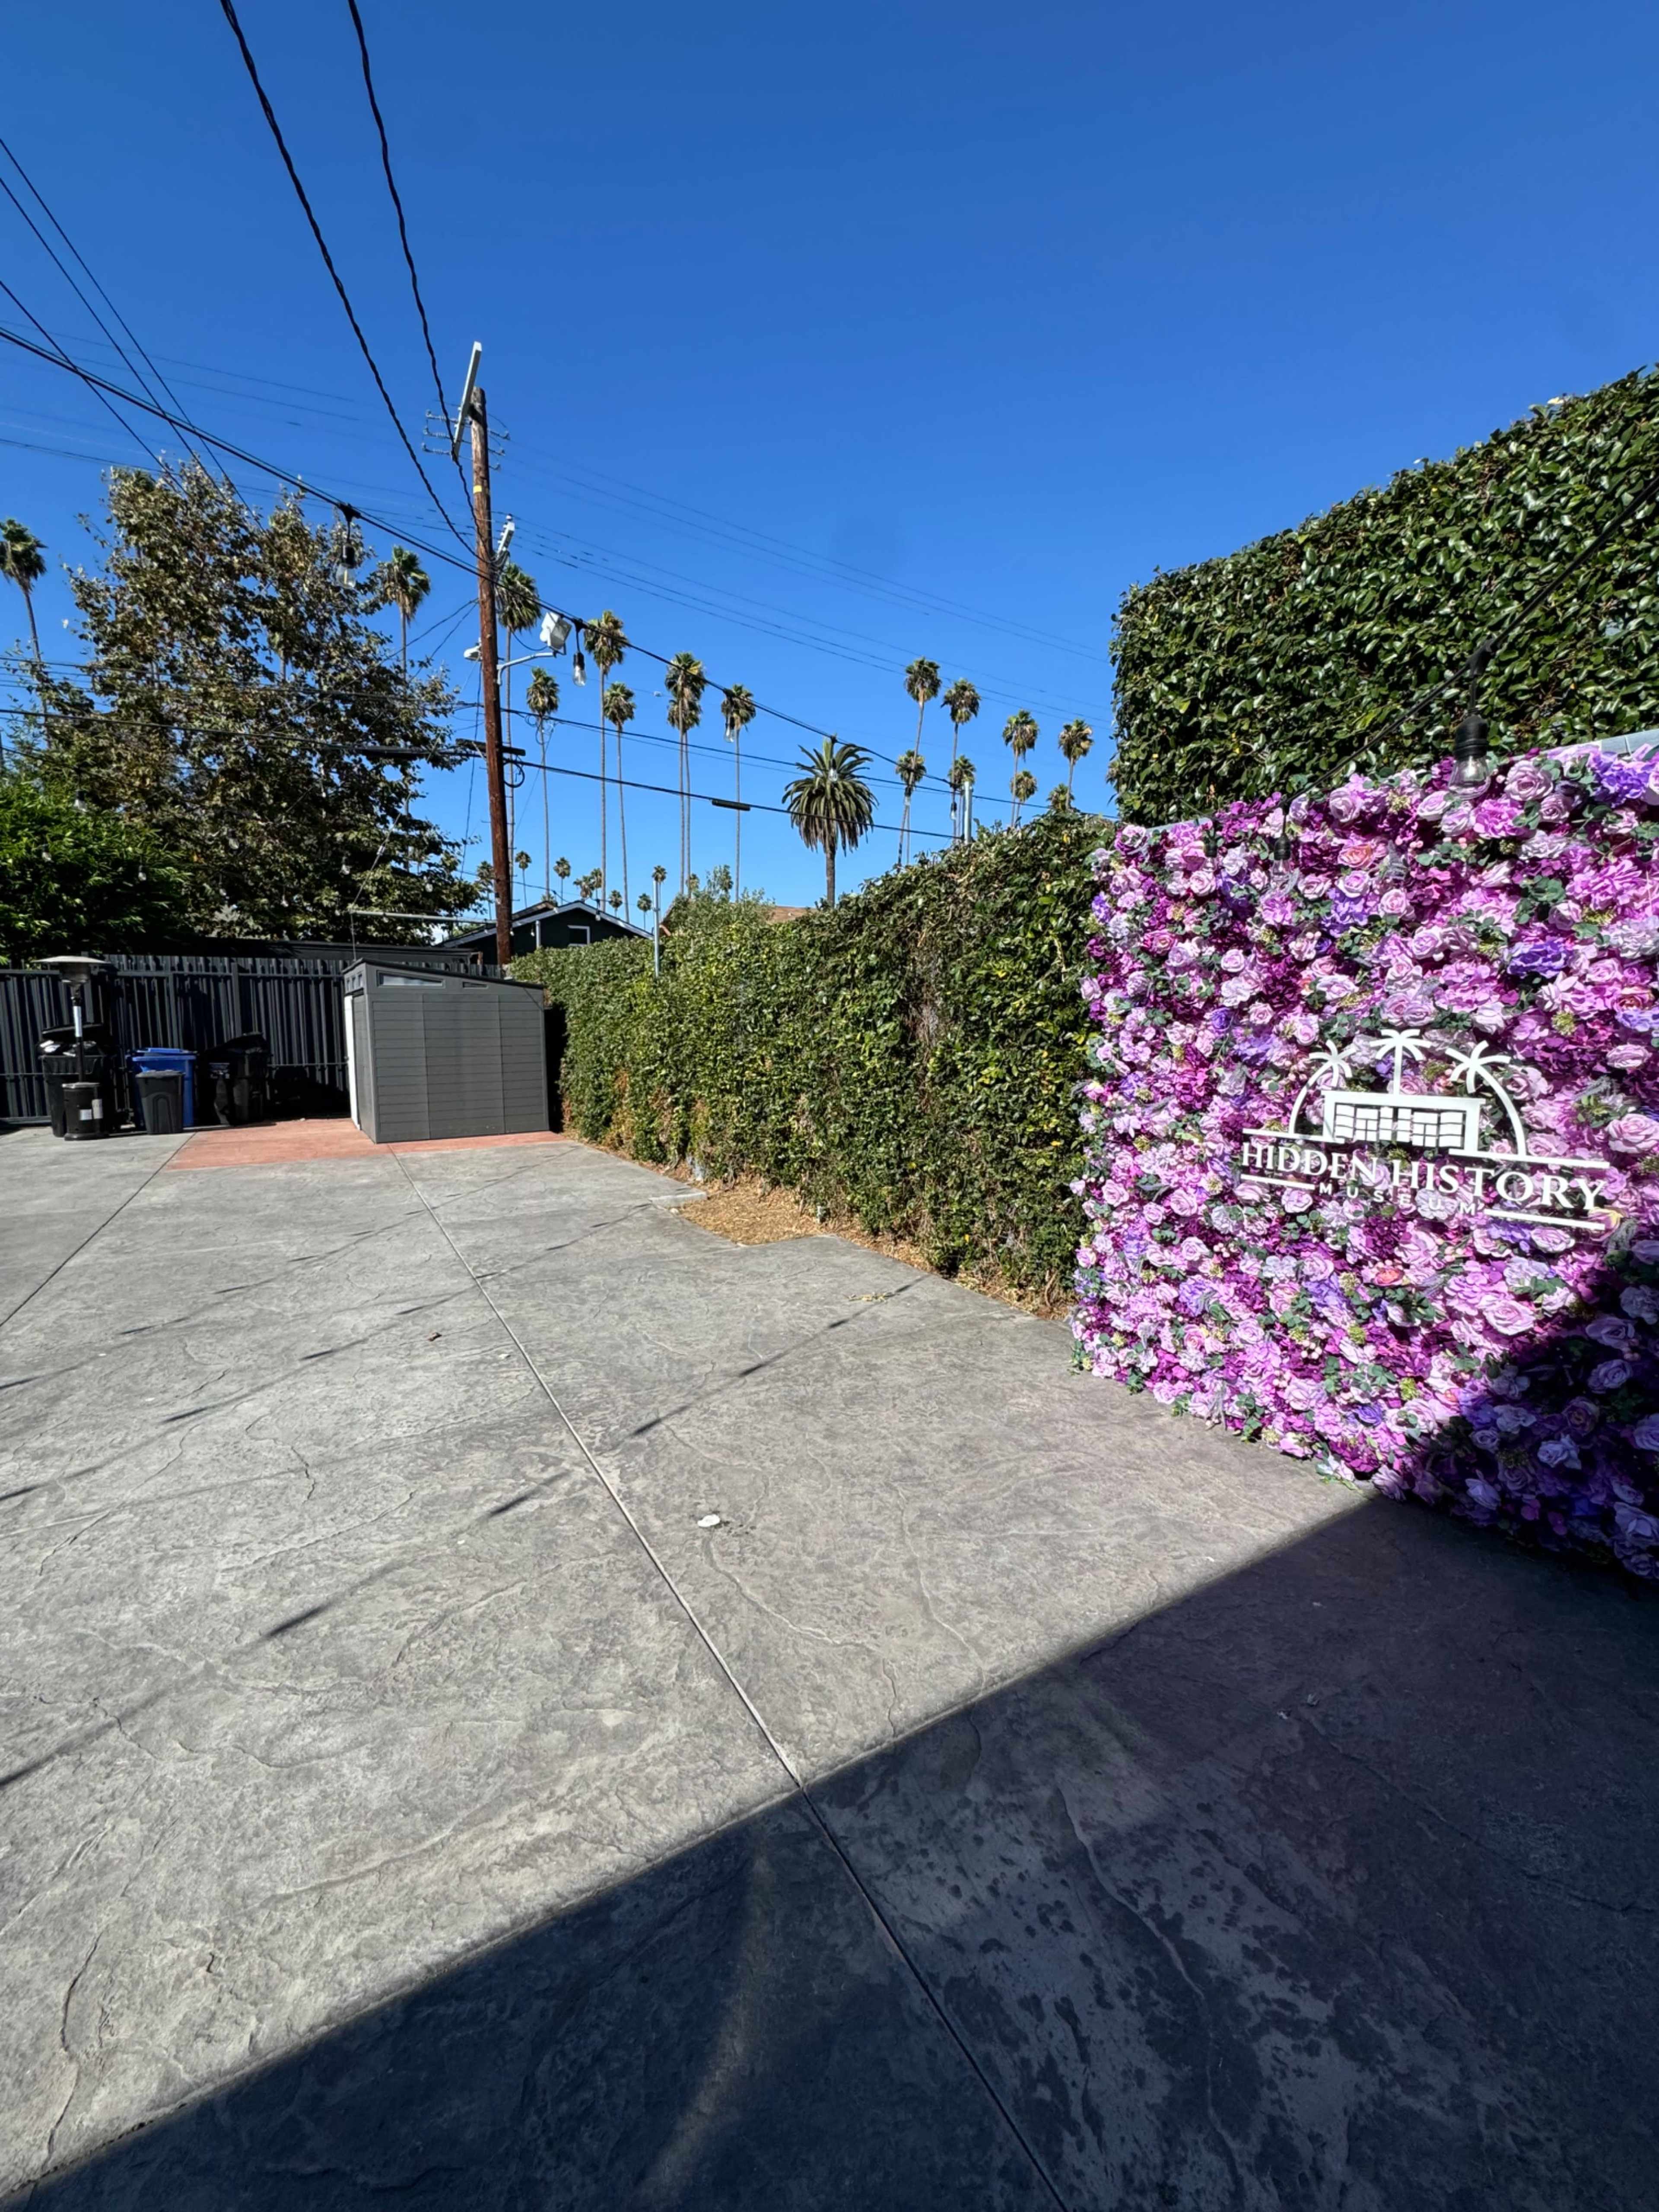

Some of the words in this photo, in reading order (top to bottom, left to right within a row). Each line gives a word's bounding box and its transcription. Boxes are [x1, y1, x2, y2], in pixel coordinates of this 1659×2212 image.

[1242, 1142, 1378, 1186] HIDDEN
[1392, 1160, 1606, 1210] HISTORY
[1319, 1182, 1475, 1216] MUSEUM
